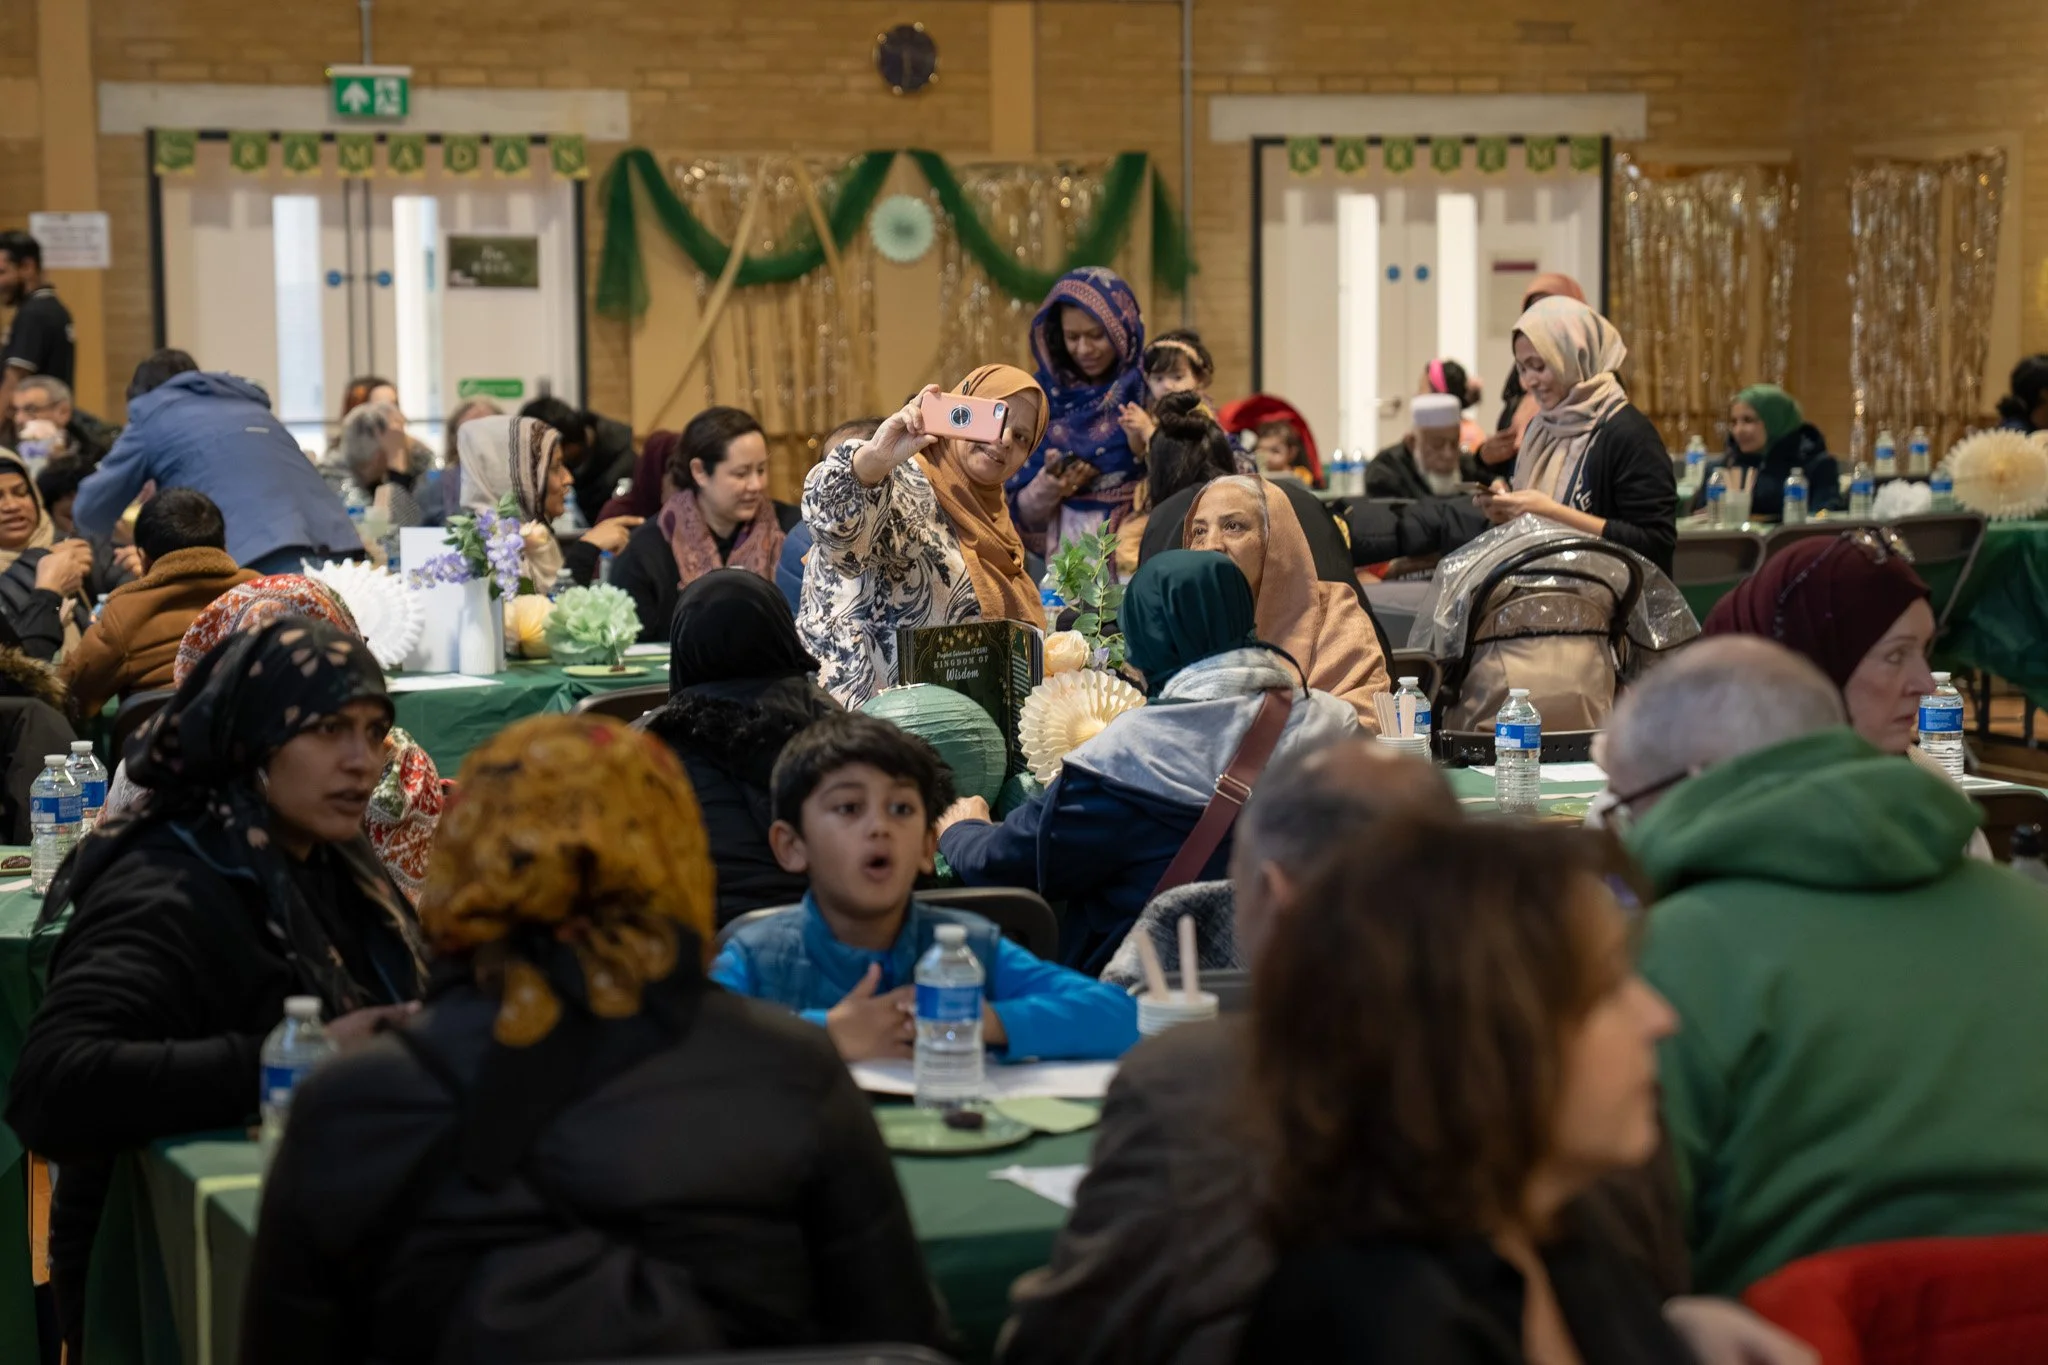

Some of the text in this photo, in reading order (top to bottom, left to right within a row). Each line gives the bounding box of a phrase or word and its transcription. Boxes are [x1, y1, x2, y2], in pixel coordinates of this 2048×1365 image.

[240, 142, 580, 169] RAMADAN
[1296, 144, 1549, 168] KAREEM
[933, 655, 989, 669] KINGDOM OF
[946, 667, 979, 681] Wisdom
